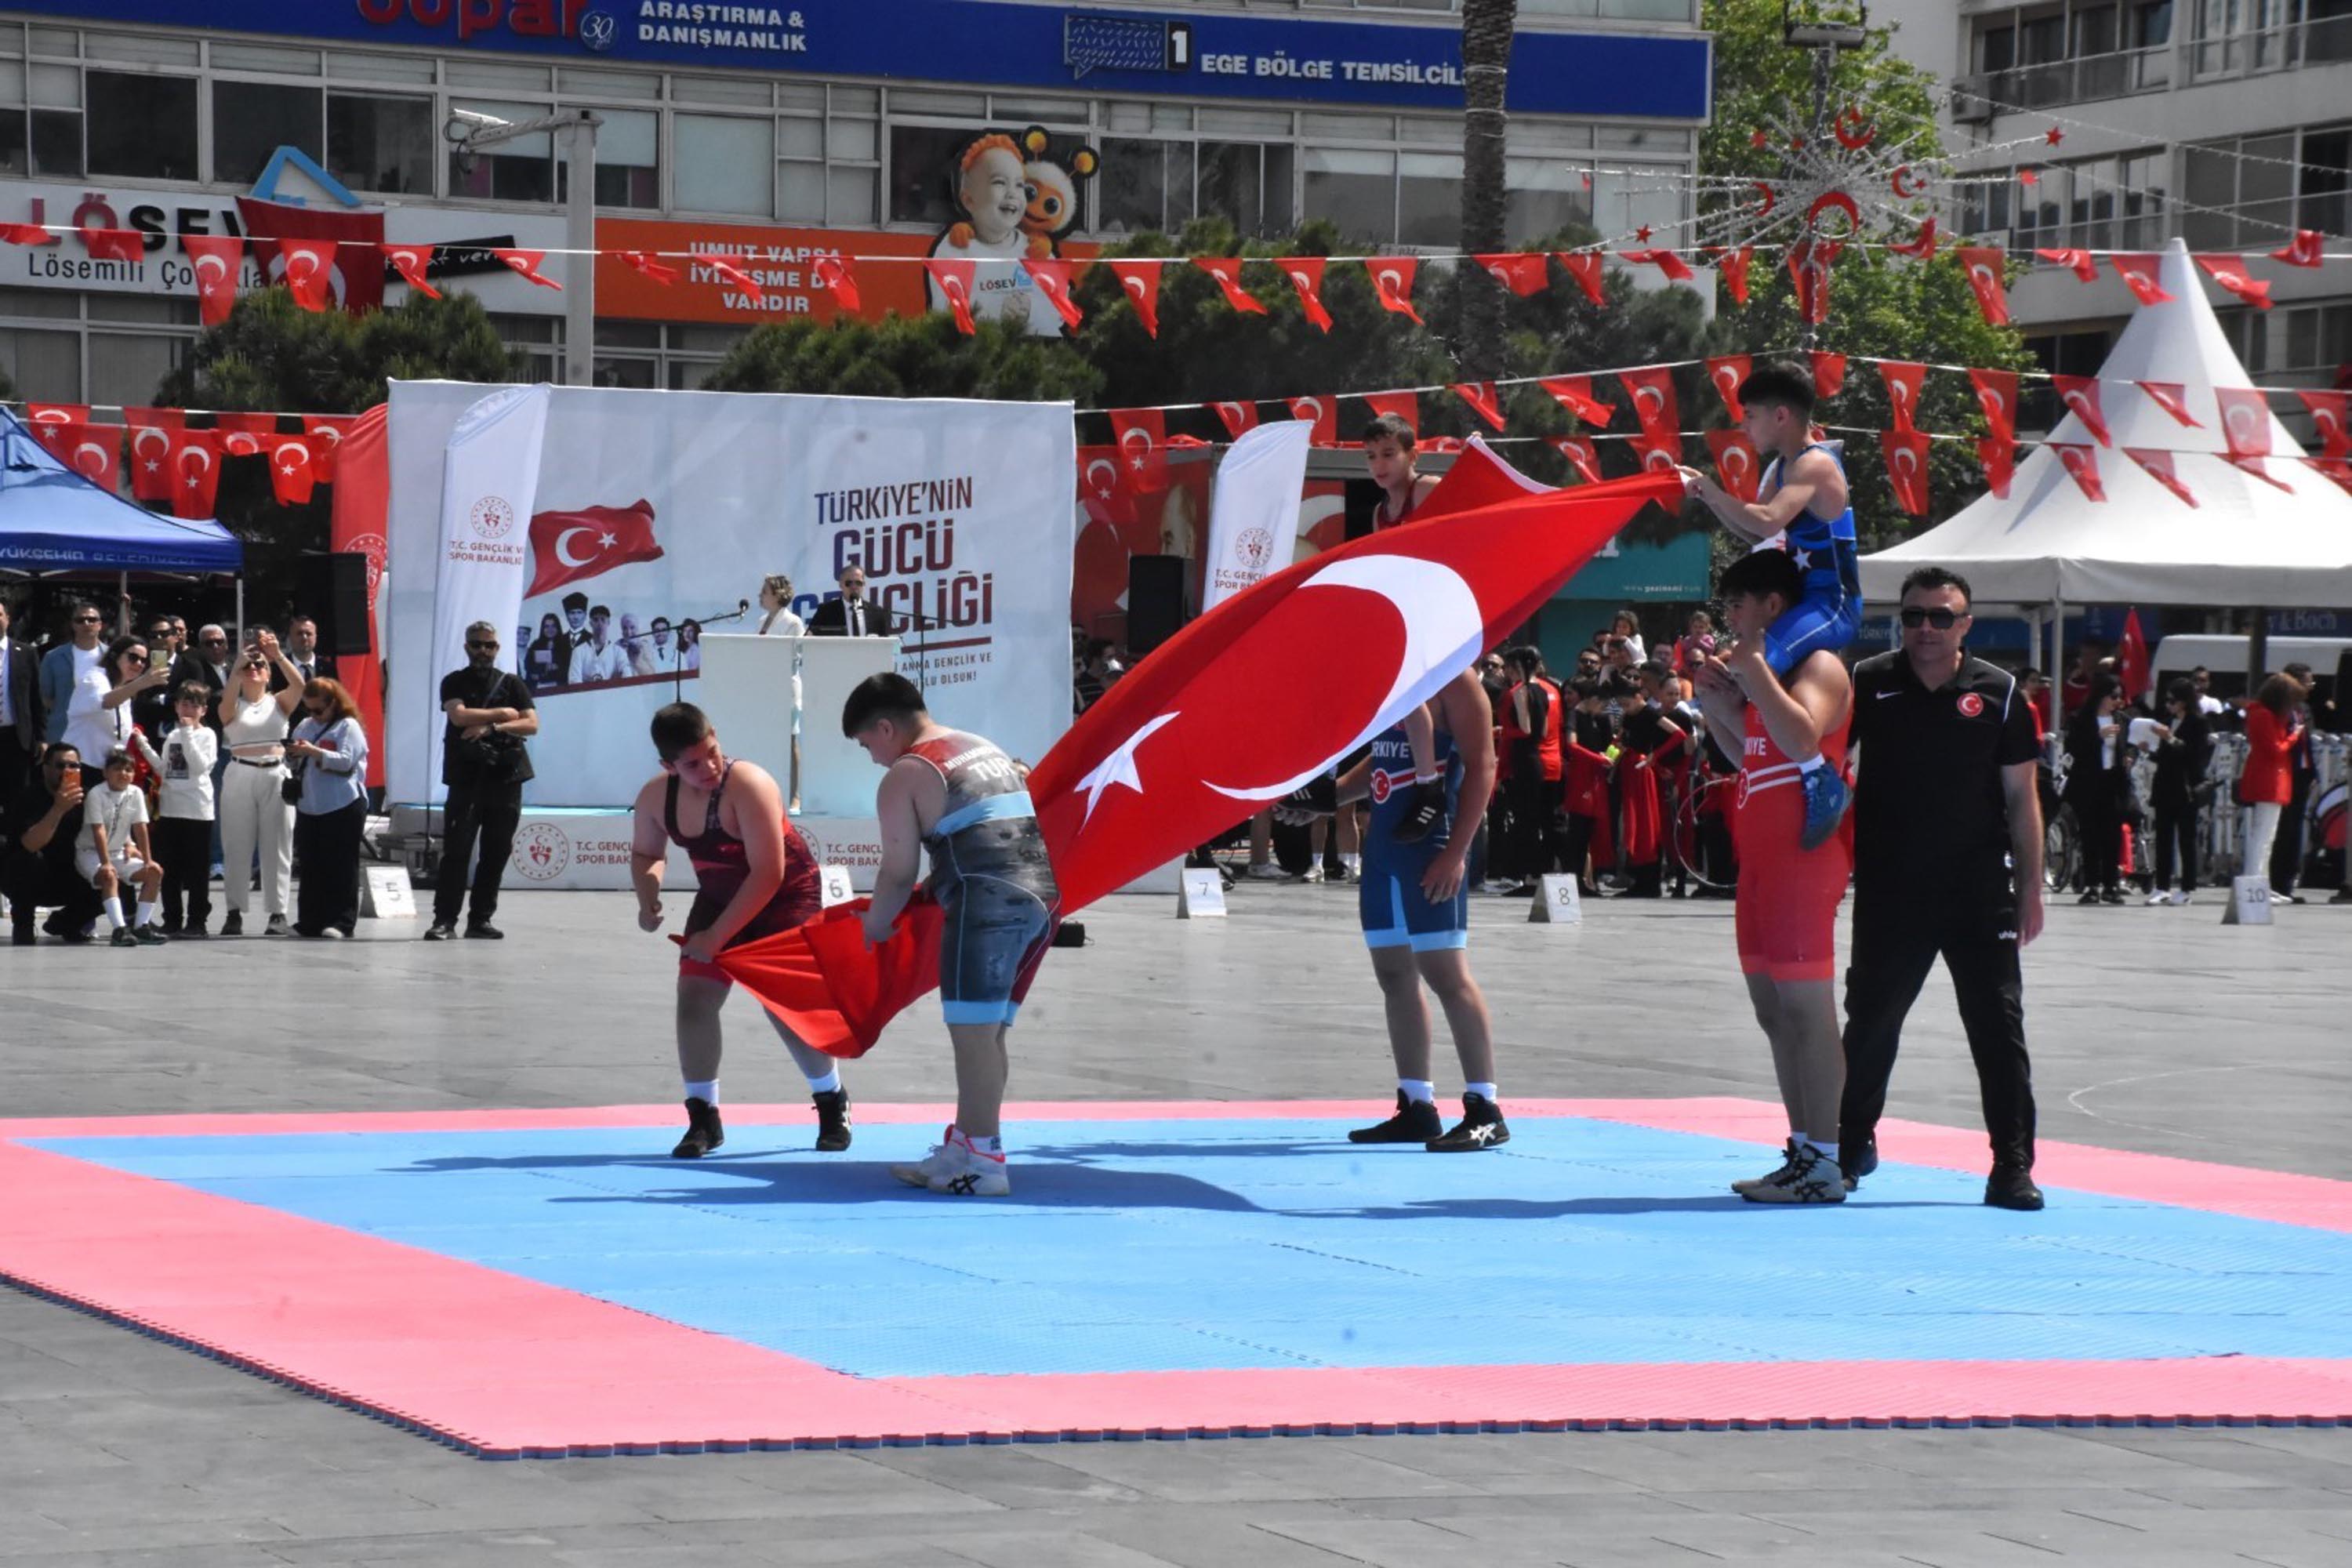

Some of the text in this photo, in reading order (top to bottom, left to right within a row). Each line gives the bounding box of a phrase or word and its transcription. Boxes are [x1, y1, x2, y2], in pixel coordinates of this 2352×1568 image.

[640, 0, 805, 28] ARAŞTIRMA &
[584, 16, 614, 38] 30
[638, 24, 807, 52] DANIŞMANLIK
[1171, 30, 1187, 63] 1
[1200, 50, 1466, 86] EGE BÖLGE TEMSİLCİL
[29, 252, 143, 283] Lösemili
[722, 292, 809, 312] VARDIR
[814, 476, 972, 525] TÜRKİYE'NİN
[449, 551, 474, 561] SPOR
[833, 518, 953, 582] GÜCÜ
[1216, 569, 1232, 579] T.C.
[1214, 580, 1237, 590] SPOR
[979, 652, 992, 662] VE
[940, 670, 977, 684] OLSUN!
[576, 841, 593, 851] T.C.
[826, 844, 845, 853] T.C.
[576, 855, 605, 864] SPOR
[826, 855, 855, 866] SPOR
[386, 882, 401, 902] 5
[829, 879, 844, 898] 6
[1198, 881, 1208, 895] 7
[1559, 887, 1570, 906] 8
[2245, 887, 2265, 903] 10
